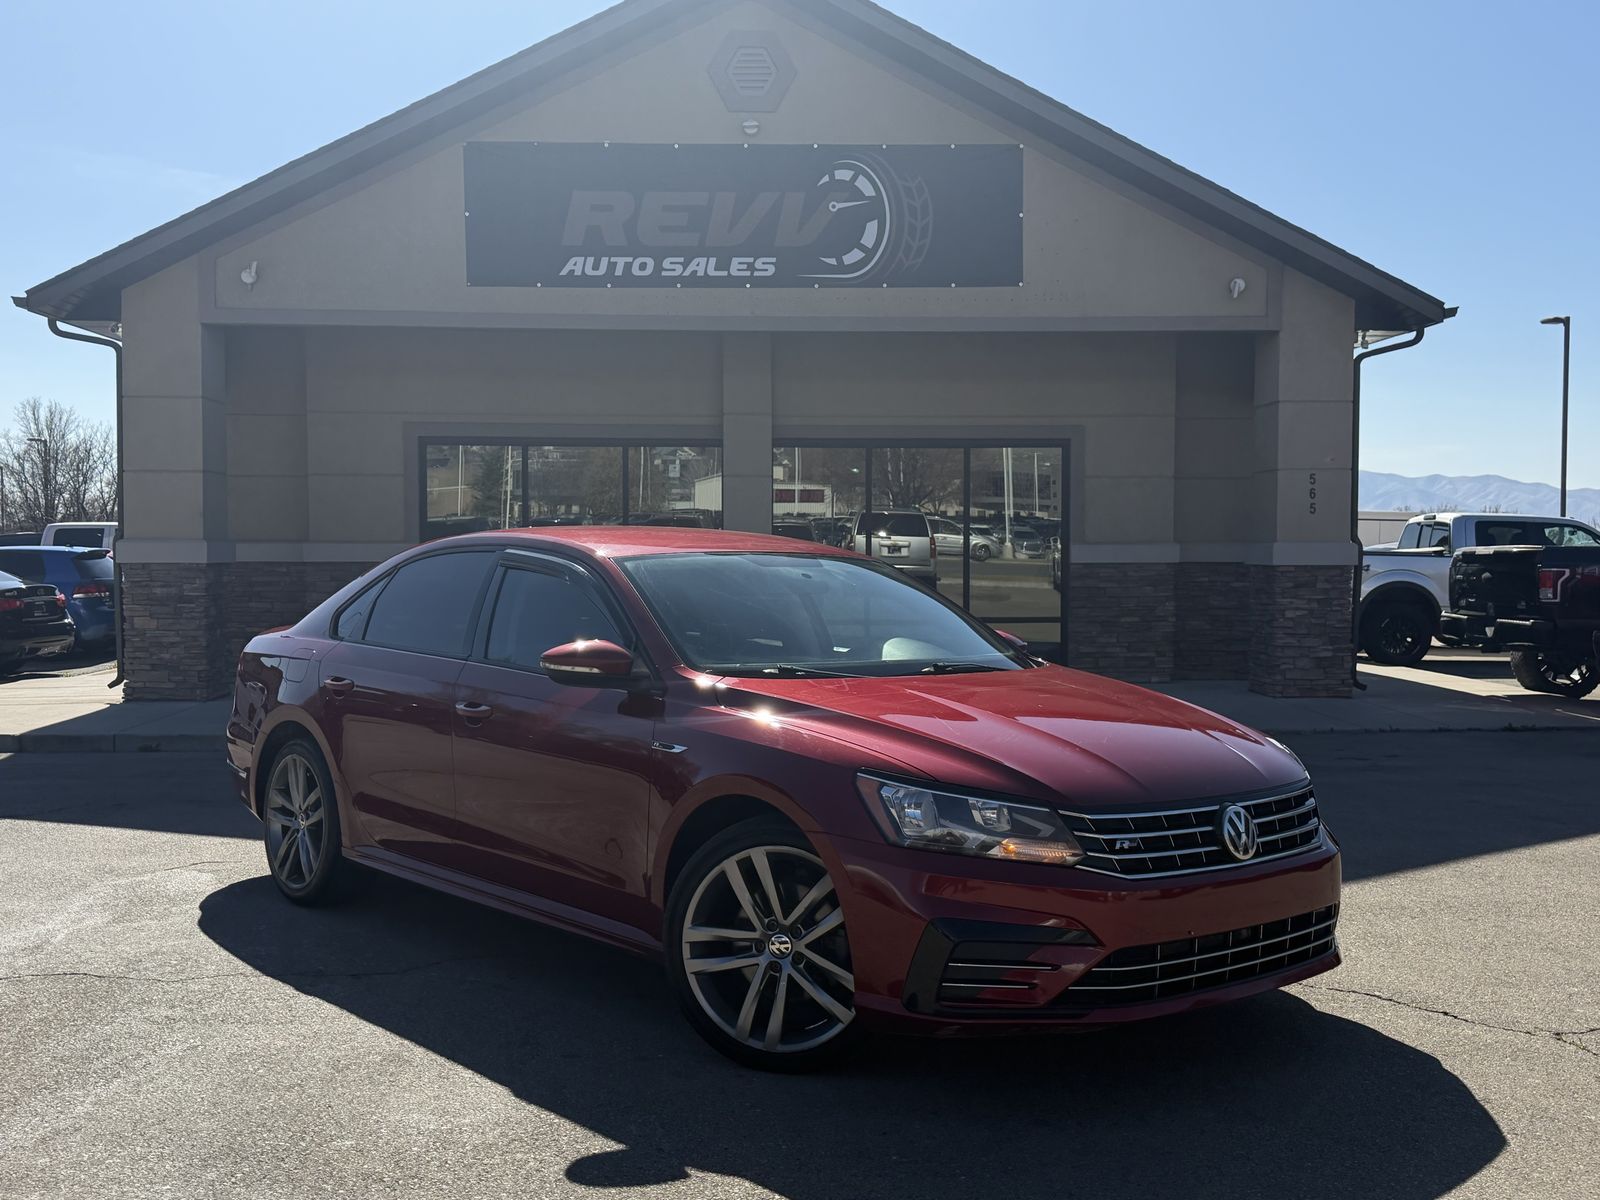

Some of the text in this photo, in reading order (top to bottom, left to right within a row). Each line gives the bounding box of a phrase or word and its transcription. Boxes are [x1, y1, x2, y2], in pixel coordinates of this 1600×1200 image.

[561, 190, 849, 247] REVV
[559, 256, 777, 278] AUTO SALES
[1308, 472, 1317, 515] 565
